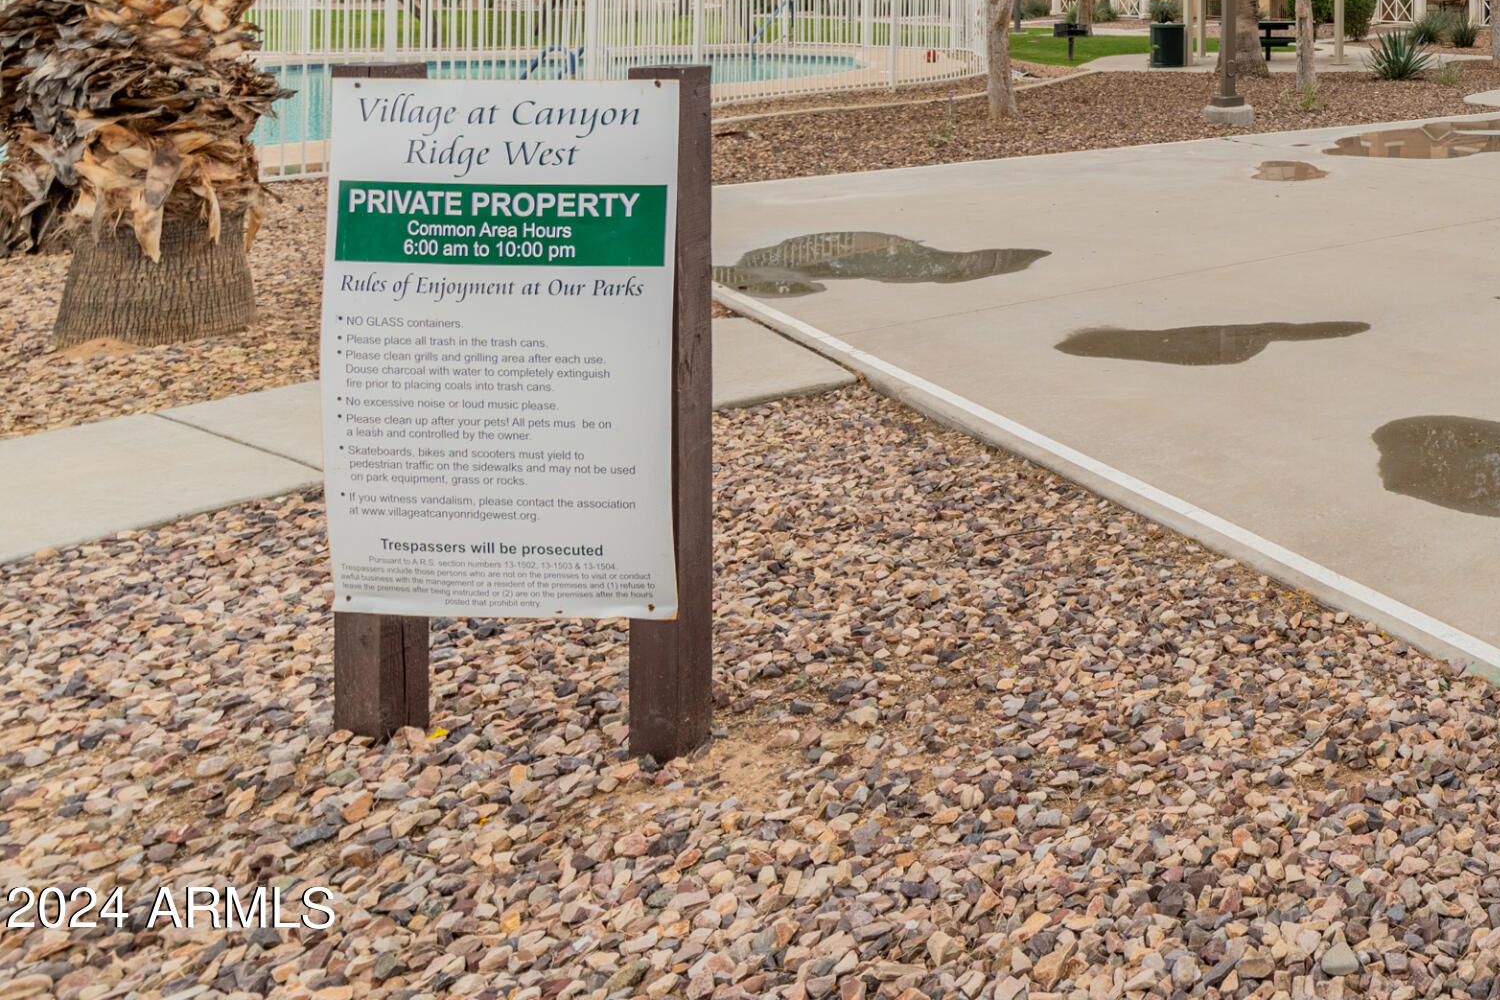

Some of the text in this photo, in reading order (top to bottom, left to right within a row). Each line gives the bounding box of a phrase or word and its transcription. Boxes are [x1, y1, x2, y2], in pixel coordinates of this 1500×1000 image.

[360, 93, 640, 138] Village at Canyon
[405, 135, 580, 178] Ridge West
[349, 188, 640, 217] PRIVATE PROPERTY
[408, 220, 572, 238] Common Area Hours
[404, 239, 575, 261] 6:00 am to 10:00 pm
[341, 272, 644, 302] Rules of Enjoyment at Our Parks
[347, 316, 464, 328] NO GLASS containers.
[347, 334, 548, 348] Please place all trash in the trash cans.
[346, 350, 606, 364] Please clean grills and grilling area after each use.
[346, 364, 610, 380] Douse charcoal with water to completely extinguish
[346, 378, 554, 392] fire prior to placing coals into trash cans.
[346, 396, 360, 406] No
[363, 398, 414, 407] excessive
[418, 400, 445, 408] noise
[462, 399, 484, 408] loud
[488, 400, 519, 410] music
[521, 400, 559, 410] please.
[346, 414, 381, 424] Please
[384, 415, 412, 424] clean
[415, 418, 428, 426] up
[431, 416, 455, 426] after
[458, 419, 481, 427] your
[484, 417, 509, 427] pets!
[512, 418, 525, 427] All
[528, 418, 550, 428] pets
[582, 419, 596, 428] be
[598, 421, 612, 429] on
[356, 427, 384, 437] leash
[386, 429, 406, 438] and
[409, 430, 459, 439] controlled
[463, 430, 475, 440] by
[478, 430, 494, 440] the
[418, 448, 445, 457] bikes
[448, 448, 468, 458] and
[472, 450, 516, 459] scooters
[519, 450, 544, 459] must
[547, 450, 571, 460] yield
[574, 451, 584, 461] to
[350, 460, 402, 469] pedestrian
[406, 460, 434, 470] traffic
[453, 462, 469, 471] the
[472, 462, 523, 472] sidewalks
[526, 464, 546, 472] and
[549, 466, 571, 475] may
[574, 465, 591, 474] not
[594, 465, 607, 474] be
[610, 465, 636, 475] used
[366, 473, 388, 483] park
[452, 476, 480, 485] grass
[497, 476, 527, 486] rocks.
[350, 492, 355, 501] If
[358, 495, 376, 504] you
[380, 494, 417, 504] witness
[479, 496, 513, 507] please
[516, 498, 554, 507] contact
[558, 498, 574, 508] the
[577, 499, 636, 509] association
[380, 538, 603, 556] Trespassers will be prosecuted
